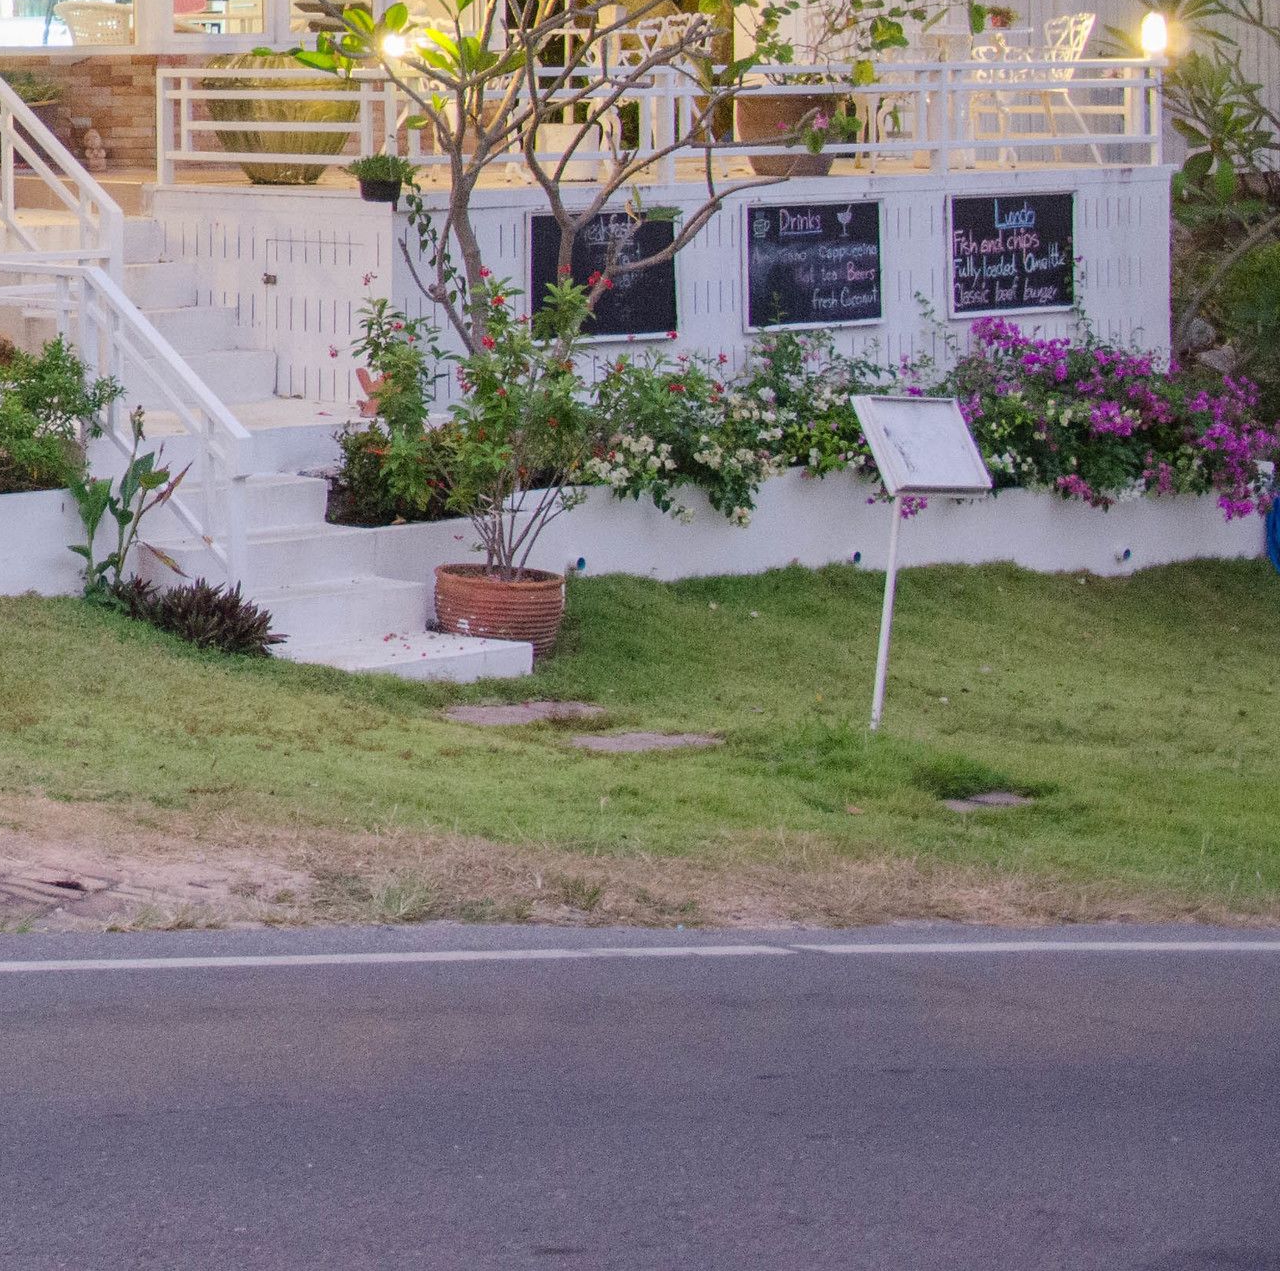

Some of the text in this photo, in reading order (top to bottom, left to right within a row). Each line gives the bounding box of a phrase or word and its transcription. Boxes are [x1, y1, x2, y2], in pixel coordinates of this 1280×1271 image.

[779, 208, 822, 232] Drinks
[994, 198, 1035, 227] Lunch
[953, 227, 1040, 265] Fish and chips
[846, 261, 876, 282] Beers
[953, 254, 981, 288] Fully
[983, 253, 1018, 278] loaded
[841, 284, 879, 308] Coconut
[952, 275, 1058, 308] Classic beef burger
